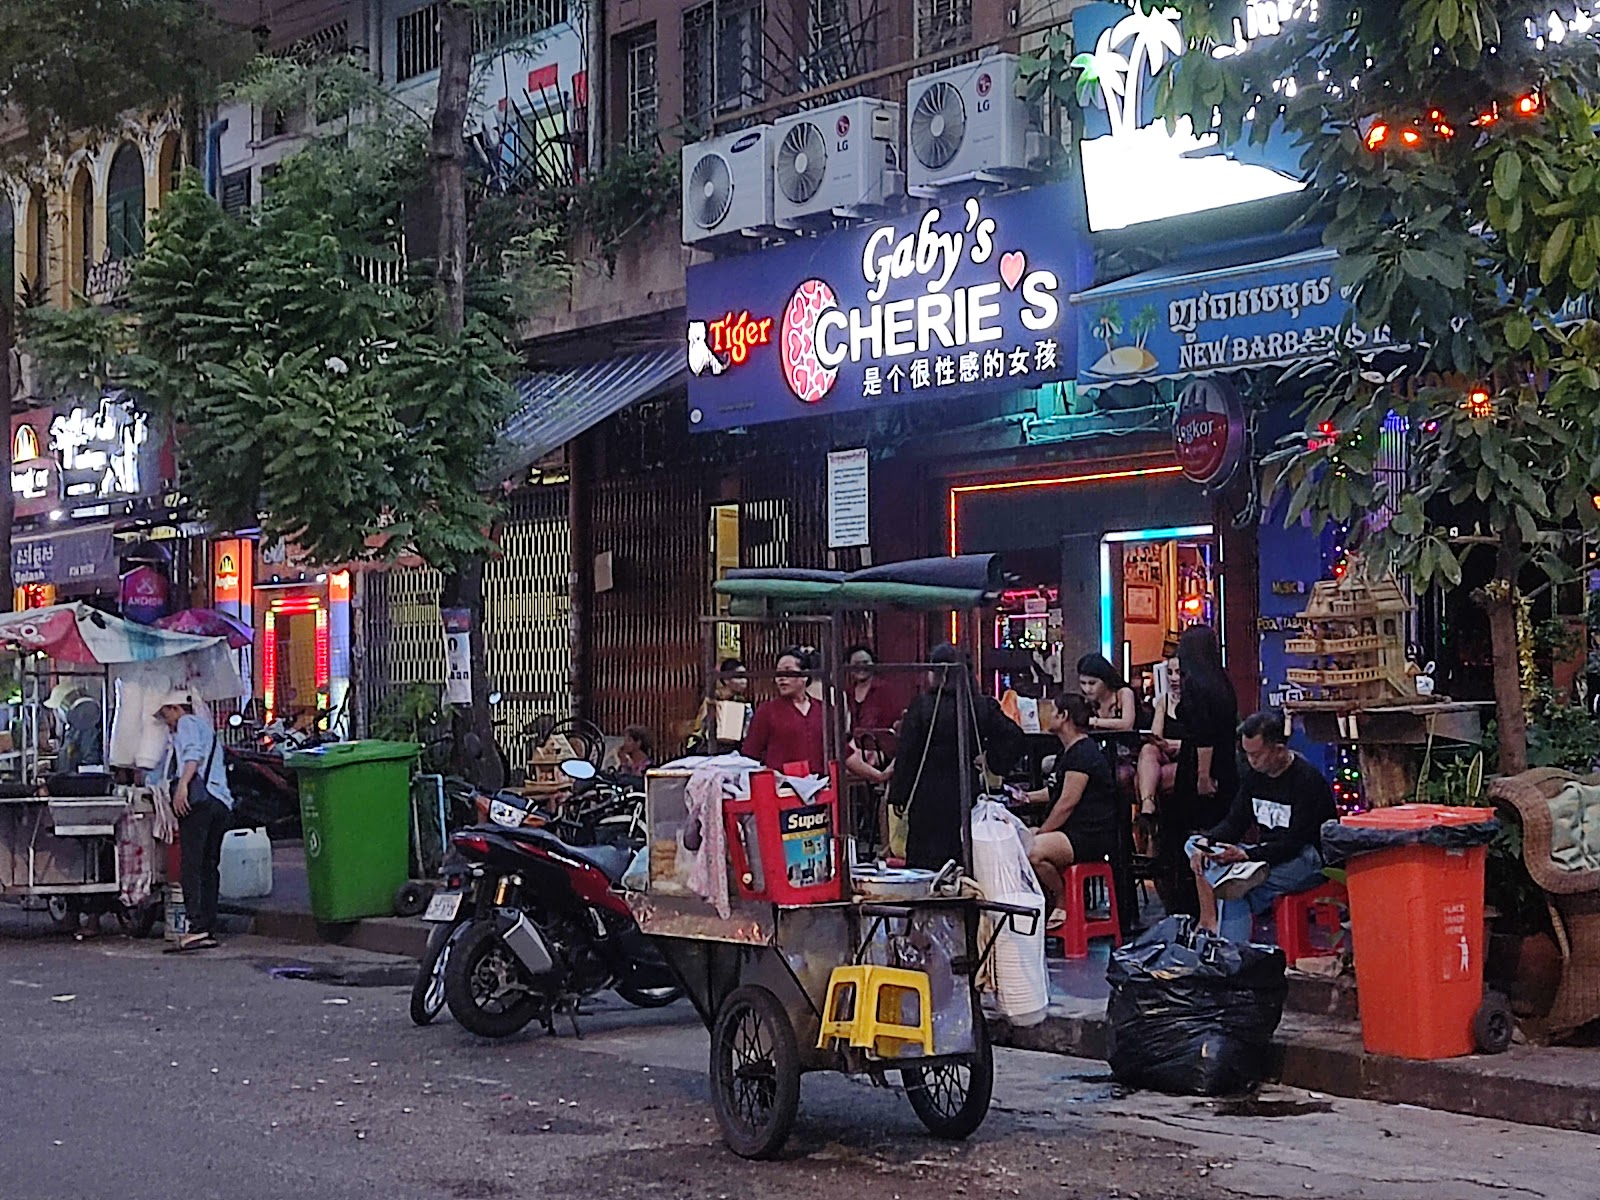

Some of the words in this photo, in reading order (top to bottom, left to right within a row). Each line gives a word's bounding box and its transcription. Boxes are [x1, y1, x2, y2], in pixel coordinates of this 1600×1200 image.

[978, 99, 990, 113] LG
[837, 139, 848, 152] LG
[862, 197, 996, 301] Gaby's
[709, 310, 771, 362] Tiger
[1180, 335, 1228, 368] NEW
[862, 339, 1057, 397] 是个很性感的女孩
[788, 812, 826, 829] Super
